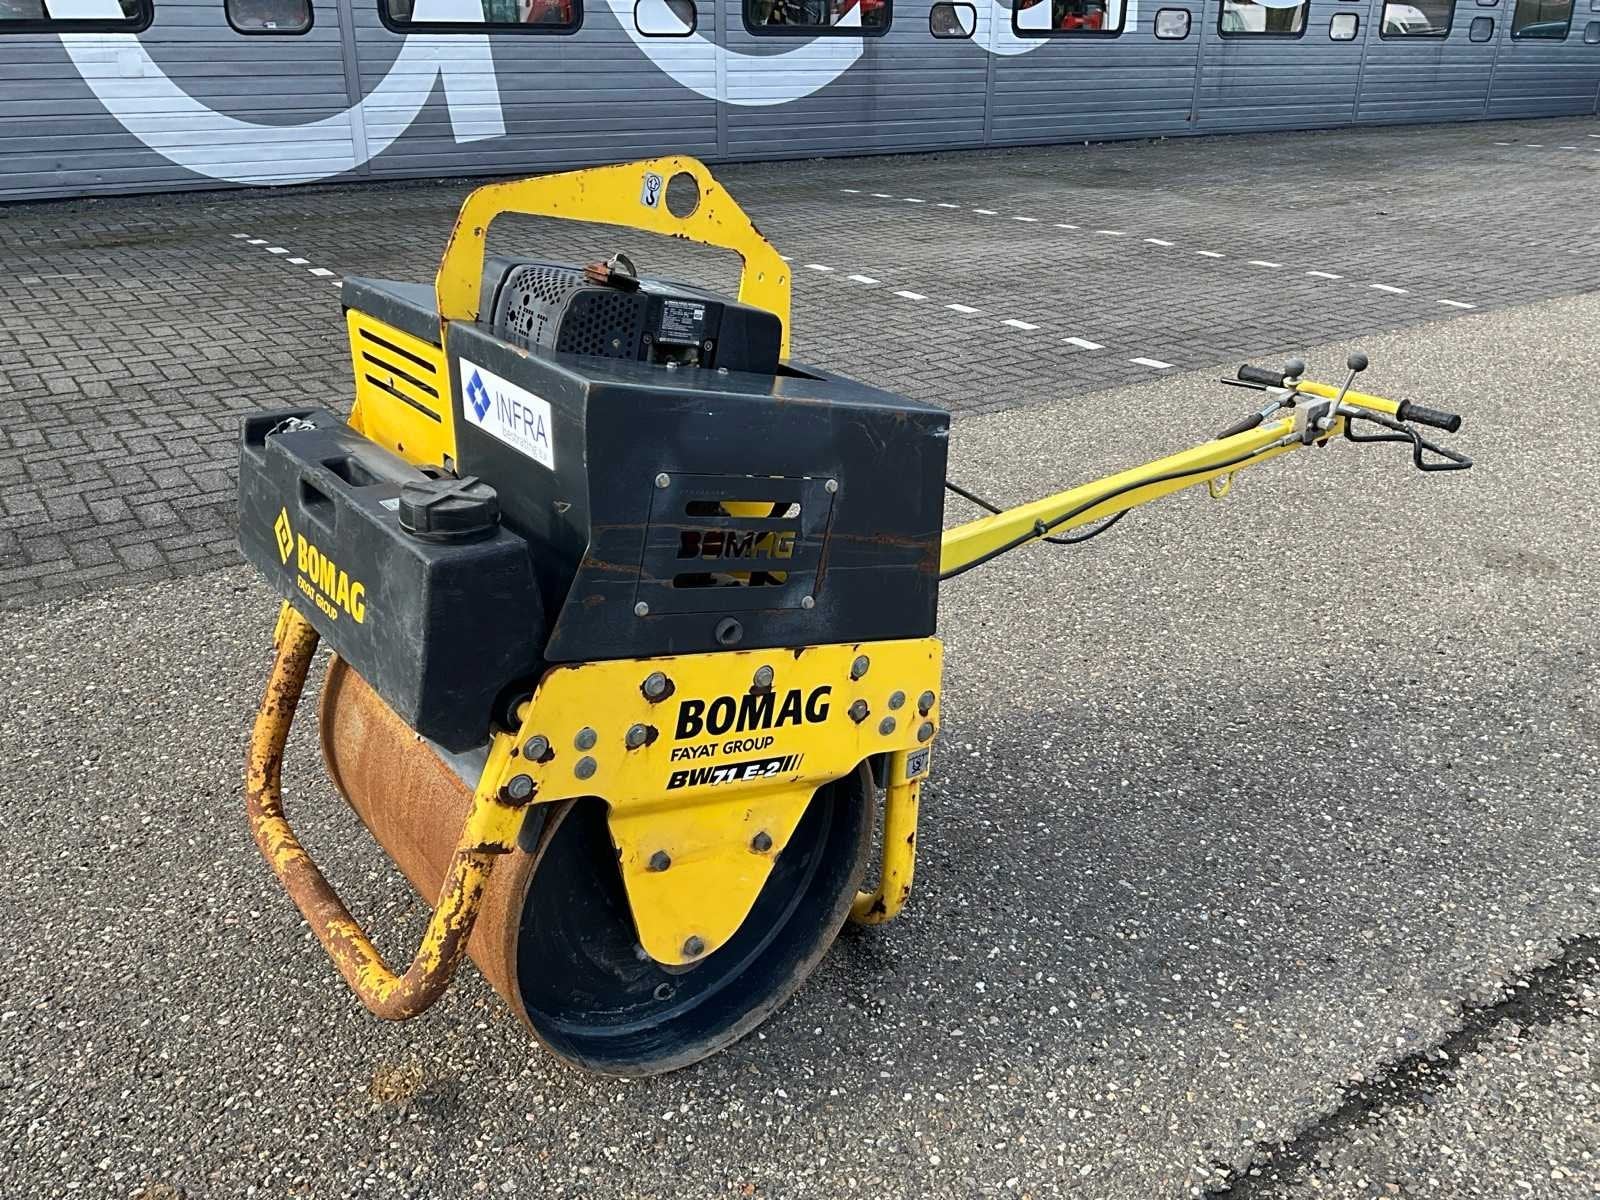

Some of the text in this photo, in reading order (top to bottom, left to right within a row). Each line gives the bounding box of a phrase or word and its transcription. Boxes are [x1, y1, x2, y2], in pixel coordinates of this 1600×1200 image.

[495, 391, 548, 448] INFRA
[677, 530, 796, 559] BOMAG
[297, 532, 365, 624] BOMAG
[297, 574, 338, 621] FAYAT GROUP
[675, 685, 833, 740] BOMAG
[670, 736, 774, 762] FAYAT GROUP
